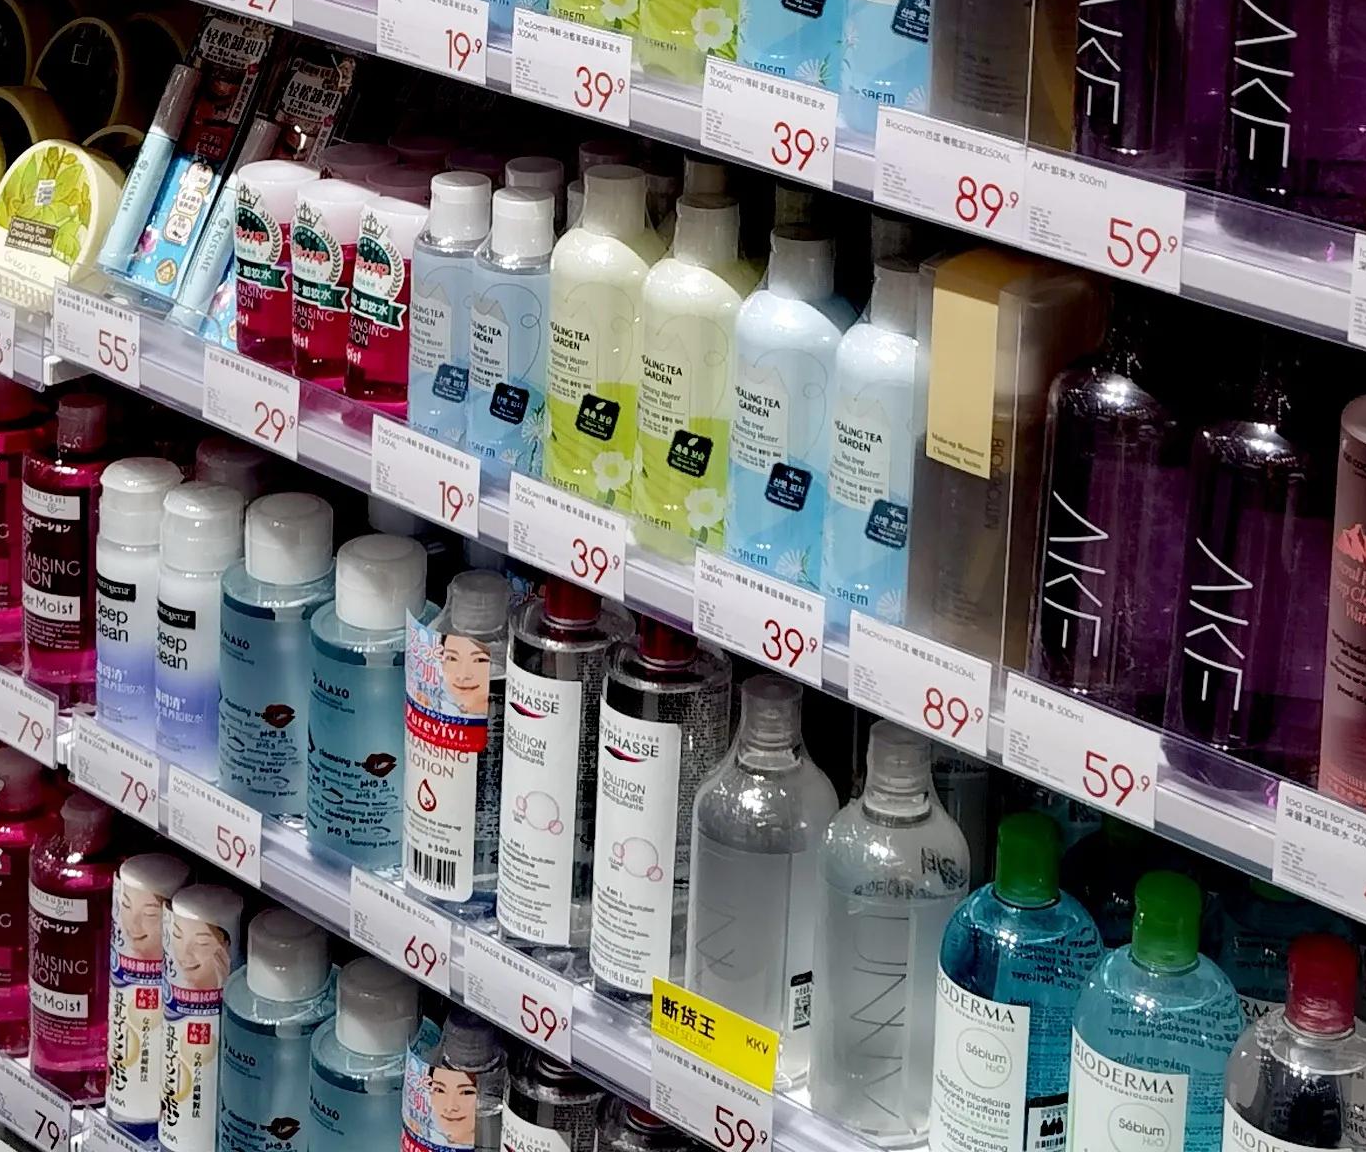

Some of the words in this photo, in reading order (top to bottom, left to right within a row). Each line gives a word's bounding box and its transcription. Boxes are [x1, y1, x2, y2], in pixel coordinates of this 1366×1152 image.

[1079, 172, 1108, 191] 500ml
[553, 334, 581, 351] GARDEN
[576, 329, 591, 343] TEA
[667, 364, 683, 377] TEA
[838, 434, 871, 453] GARDEN
[36, 596, 73, 615] Moist
[410, 753, 455, 779] LOTION
[662, 996, 715, 1040] 断货王
[746, 1035, 769, 1055] KKV
[965, 1042, 1007, 1064] Sébium
[1074, 1039, 1175, 1096] BIODERMA
[1118, 1117, 1165, 1137] Sébium
